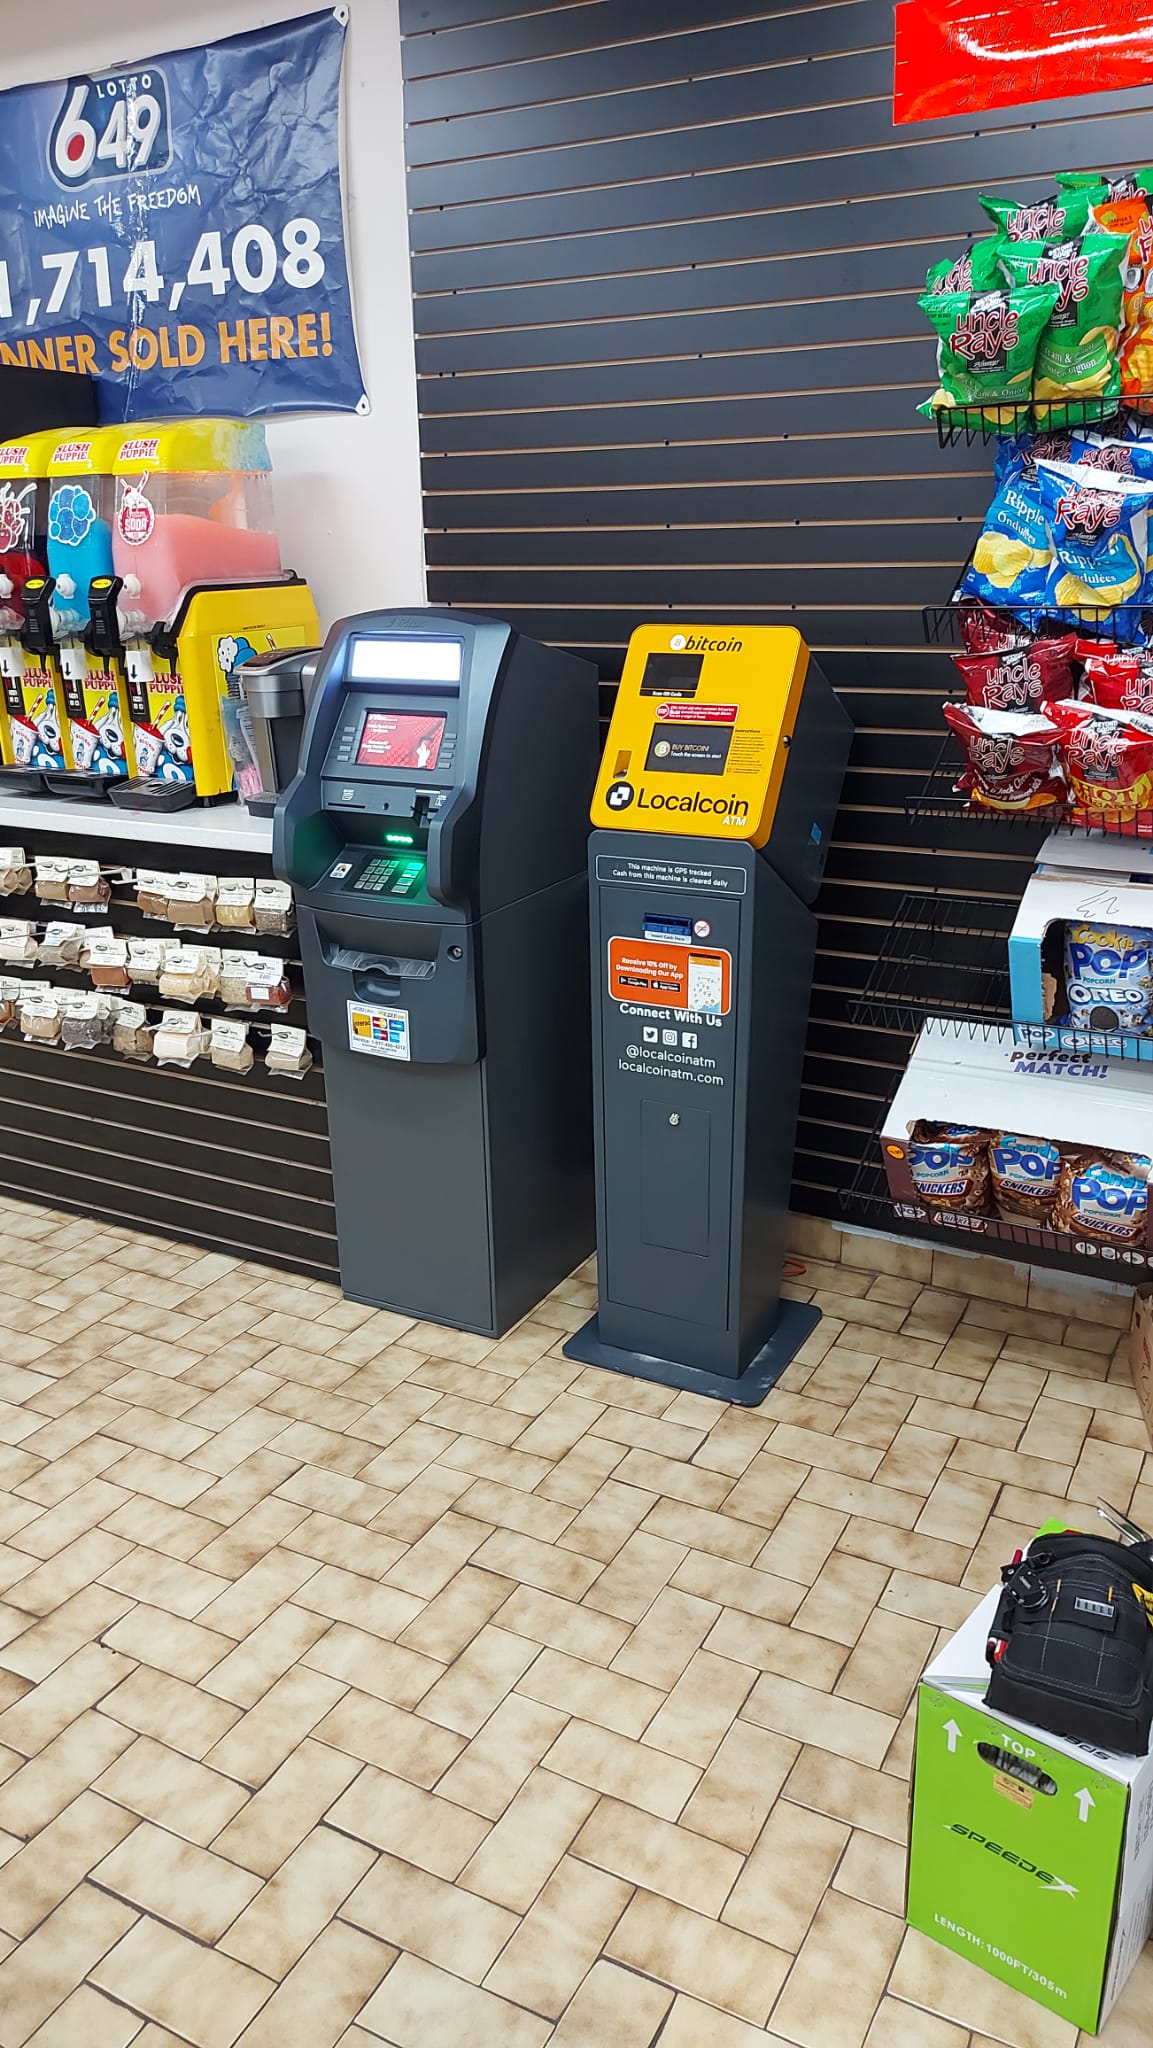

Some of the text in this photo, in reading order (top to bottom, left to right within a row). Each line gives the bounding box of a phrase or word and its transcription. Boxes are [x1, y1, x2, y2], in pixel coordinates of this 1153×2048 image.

[98, 72, 152, 100] LOTTO
[94, 191, 123, 222] THE
[128, 183, 201, 213] FREEDOM
[1007, 207, 1066, 232] uncle
[1027, 252, 1089, 283] uncle
[956, 302, 1020, 332] uncle
[109, 324, 206, 373] SOLD
[218, 312, 333, 364] HERE!
[1064, 353, 1073, 363] &
[56, 443, 91, 453] SLUSH
[123, 440, 159, 450] SLUSH
[1004, 490, 1045, 526] Ripple
[125, 518, 148, 531] SODA
[685, 635, 743, 653] bitcoin
[986, 657, 1042, 686] uncle
[637, 788, 750, 817] Localcoin
[722, 816, 747, 827] ATM
[612, 869, 628, 877] Cash
[628, 871, 642, 879] from
[644, 872, 655, 880] this
[656, 874, 681, 882] machine
[689, 876, 712, 885] cleared
[713, 879, 728, 888] daily
[642, 865, 667, 873] machine
[689, 869, 712, 877] tracked
[1073, 923, 1135, 951] Cookie
[616, 964, 684, 980] Downloading Our App
[621, 957, 646, 967] Receive
[658, 961, 669, 969] Off
[669, 963, 678, 971] by
[1070, 943, 1148, 979] POP
[1083, 977, 1116, 985] POPCORN
[1070, 984, 1143, 1004] OREO
[619, 1003, 722, 1028] Connect With Us
[625, 1044, 716, 1069] @localcoinatm
[1010, 1050, 1092, 1064] perfect
[618, 1058, 725, 1087] localcoinatm.com
[1014, 1061, 1109, 1080] MATCH!
[1001, 1136, 1060, 1162] Candy
[992, 1148, 1063, 1180] POP
[1085, 1164, 1147, 1190] Candy
[1072, 1177, 1148, 1216] POP
[1073, 1213, 1134, 1237] SNICKERS
[1001, 1734, 1036, 1758] TOP
[948, 1823, 1080, 1900] SPEEDEX
